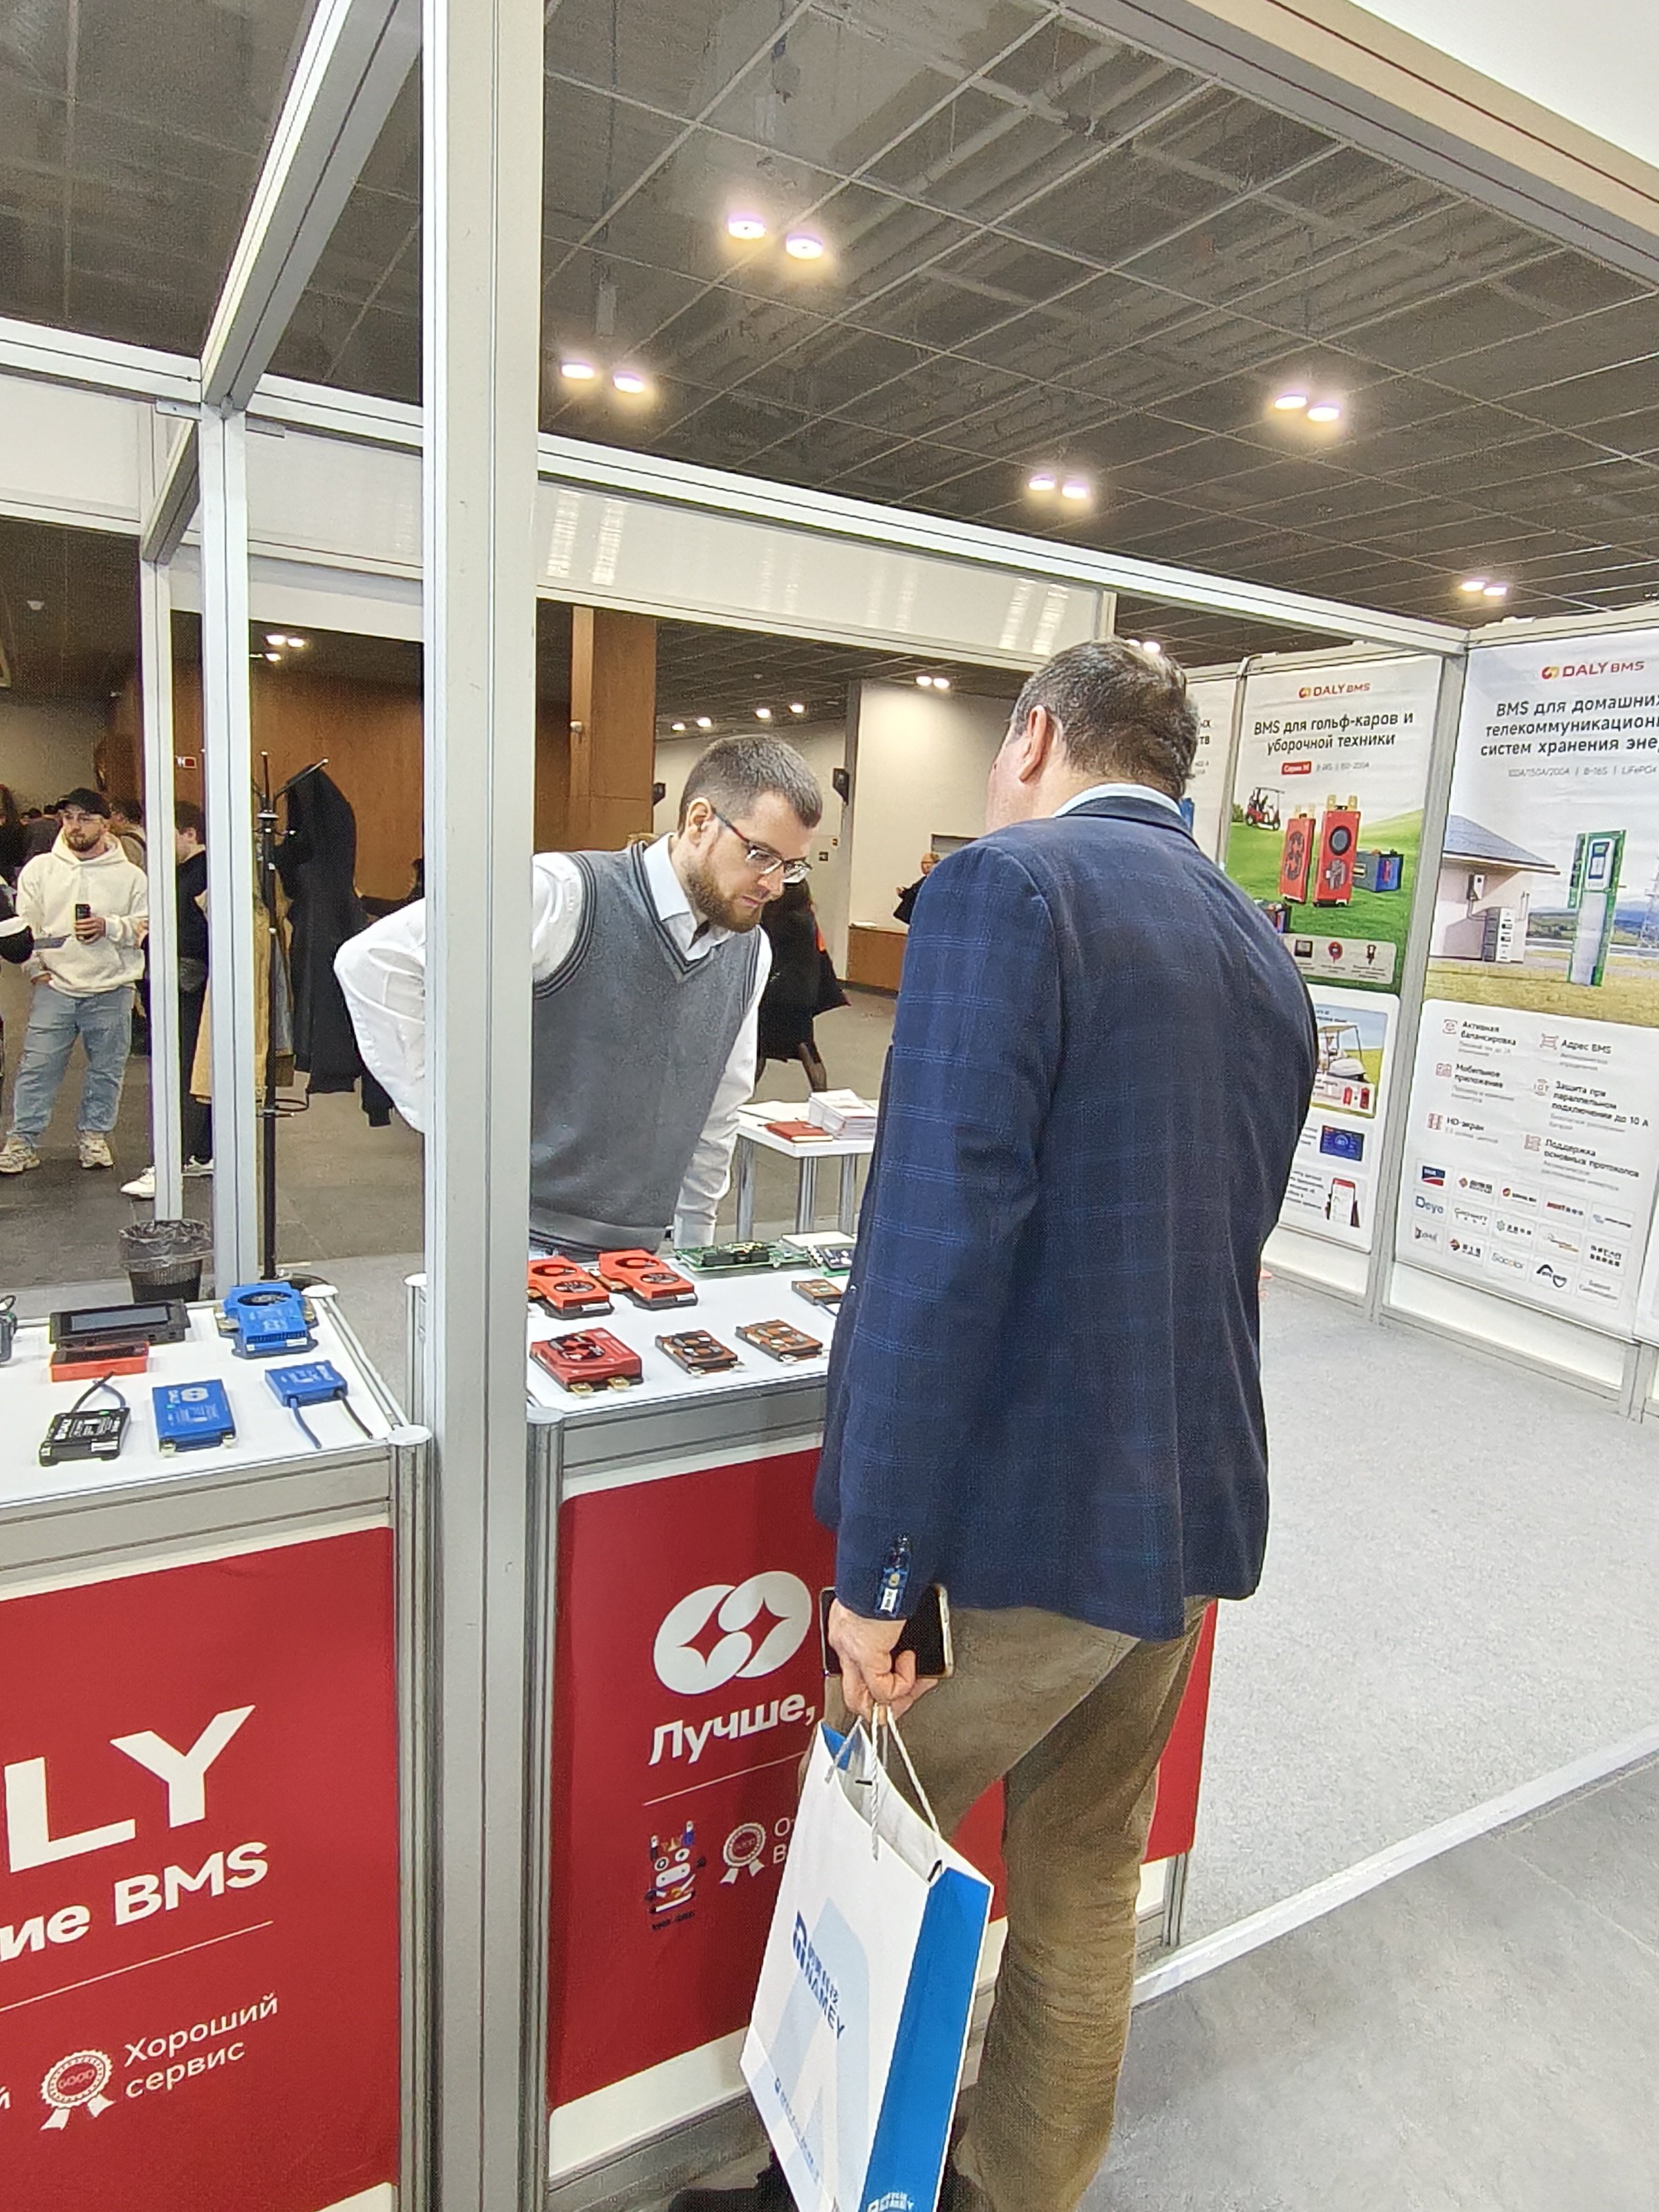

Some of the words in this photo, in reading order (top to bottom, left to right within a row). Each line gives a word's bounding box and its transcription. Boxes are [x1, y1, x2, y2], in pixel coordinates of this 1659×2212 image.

[1562, 662, 1609, 677] DALY
[1611, 661, 1644, 673] BMS
[1313, 683, 1346, 697] DALY
[1346, 683, 1371, 693] BMS
[1496, 700, 1530, 717] BMS
[1534, 701, 1566, 716] для
[1253, 720, 1280, 735] BMS
[1283, 720, 1308, 735] для
[1311, 713, 1398, 731] гольф-каров
[1403, 712, 1414, 724] и
[1267, 735, 1333, 756] уборочной
[1338, 734, 1396, 747] техники
[1481, 742, 1532, 756] систем
[1537, 738, 1619, 757] хранения
[1626, 737, 1659, 753] эне
[648, 1694, 816, 1766] Лучше,
[4, 1704, 256, 1873] LY
[114, 1841, 269, 1926] BMS
[124, 1990, 279, 2068] Хороший
[124, 2041, 246, 2099] сервис
